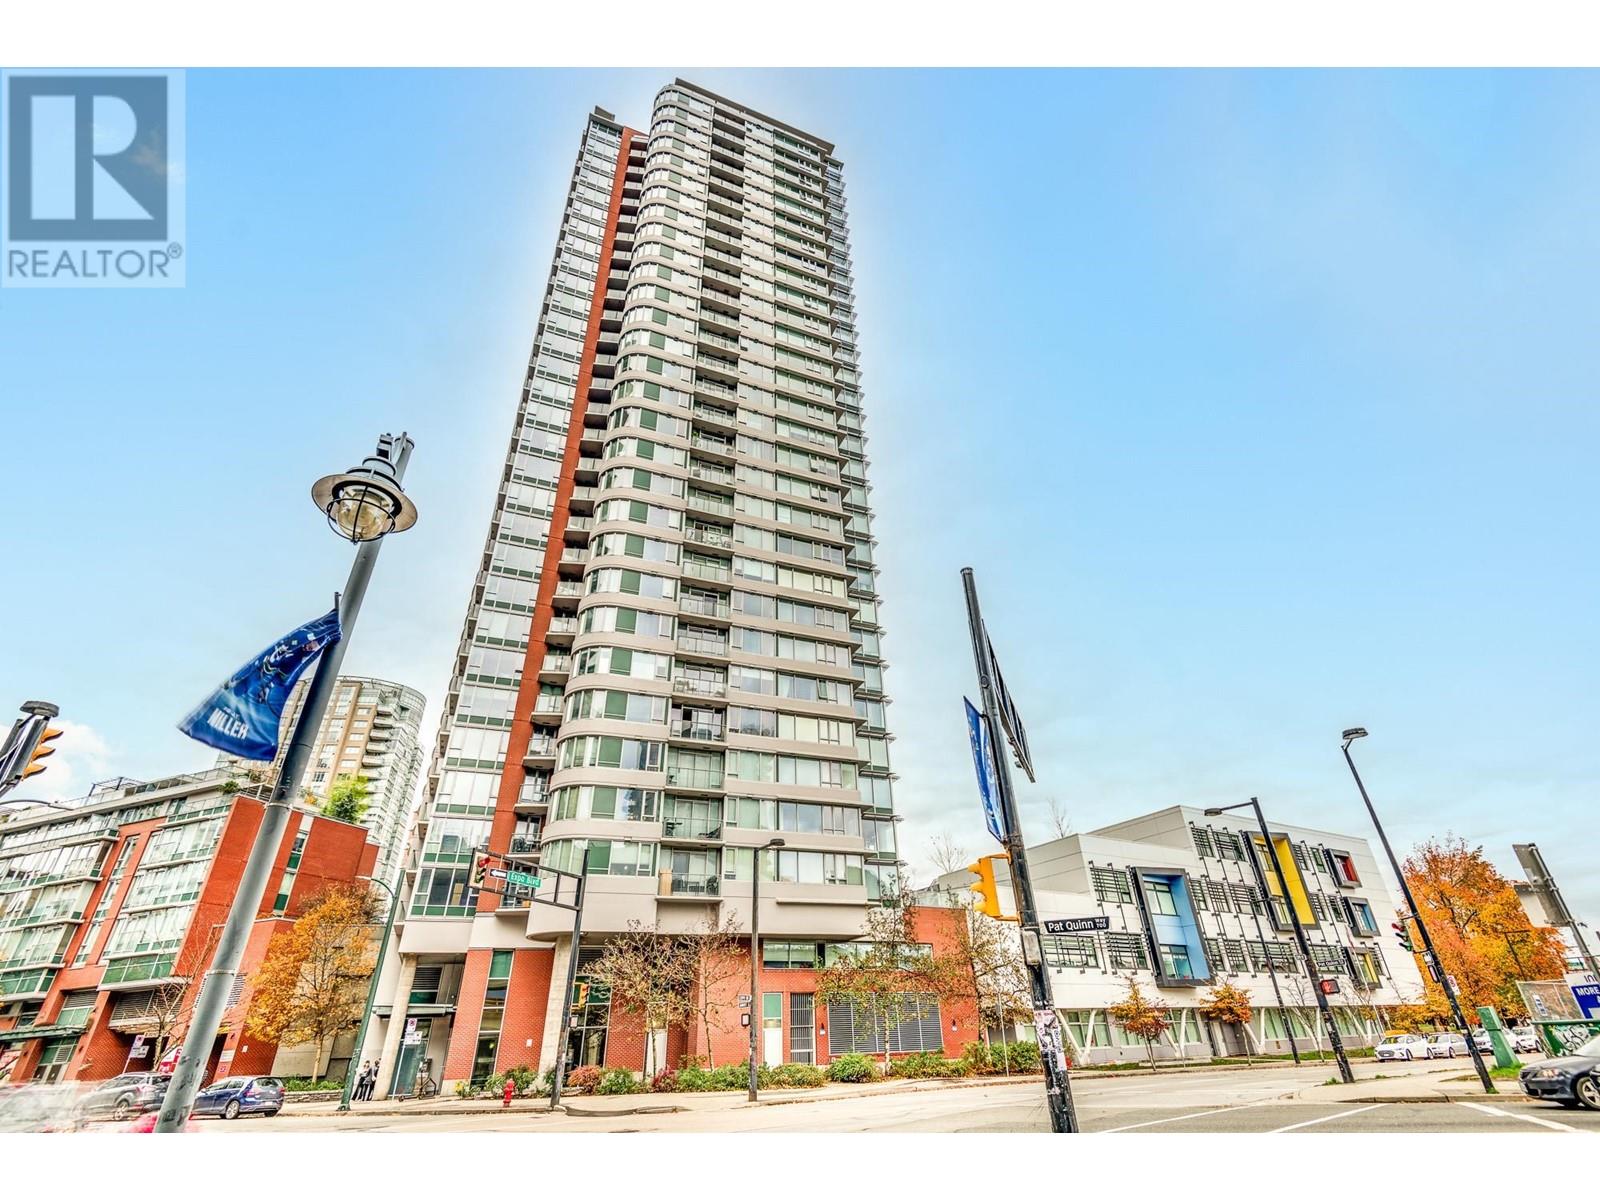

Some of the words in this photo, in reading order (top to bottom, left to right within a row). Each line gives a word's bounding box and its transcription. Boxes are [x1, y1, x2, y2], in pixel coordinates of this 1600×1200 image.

[510, 872, 525, 883] Expo
[526, 876, 540, 886] Blvd
[1048, 922, 1064, 932] Pat
[1065, 919, 1094, 931] Quinn
